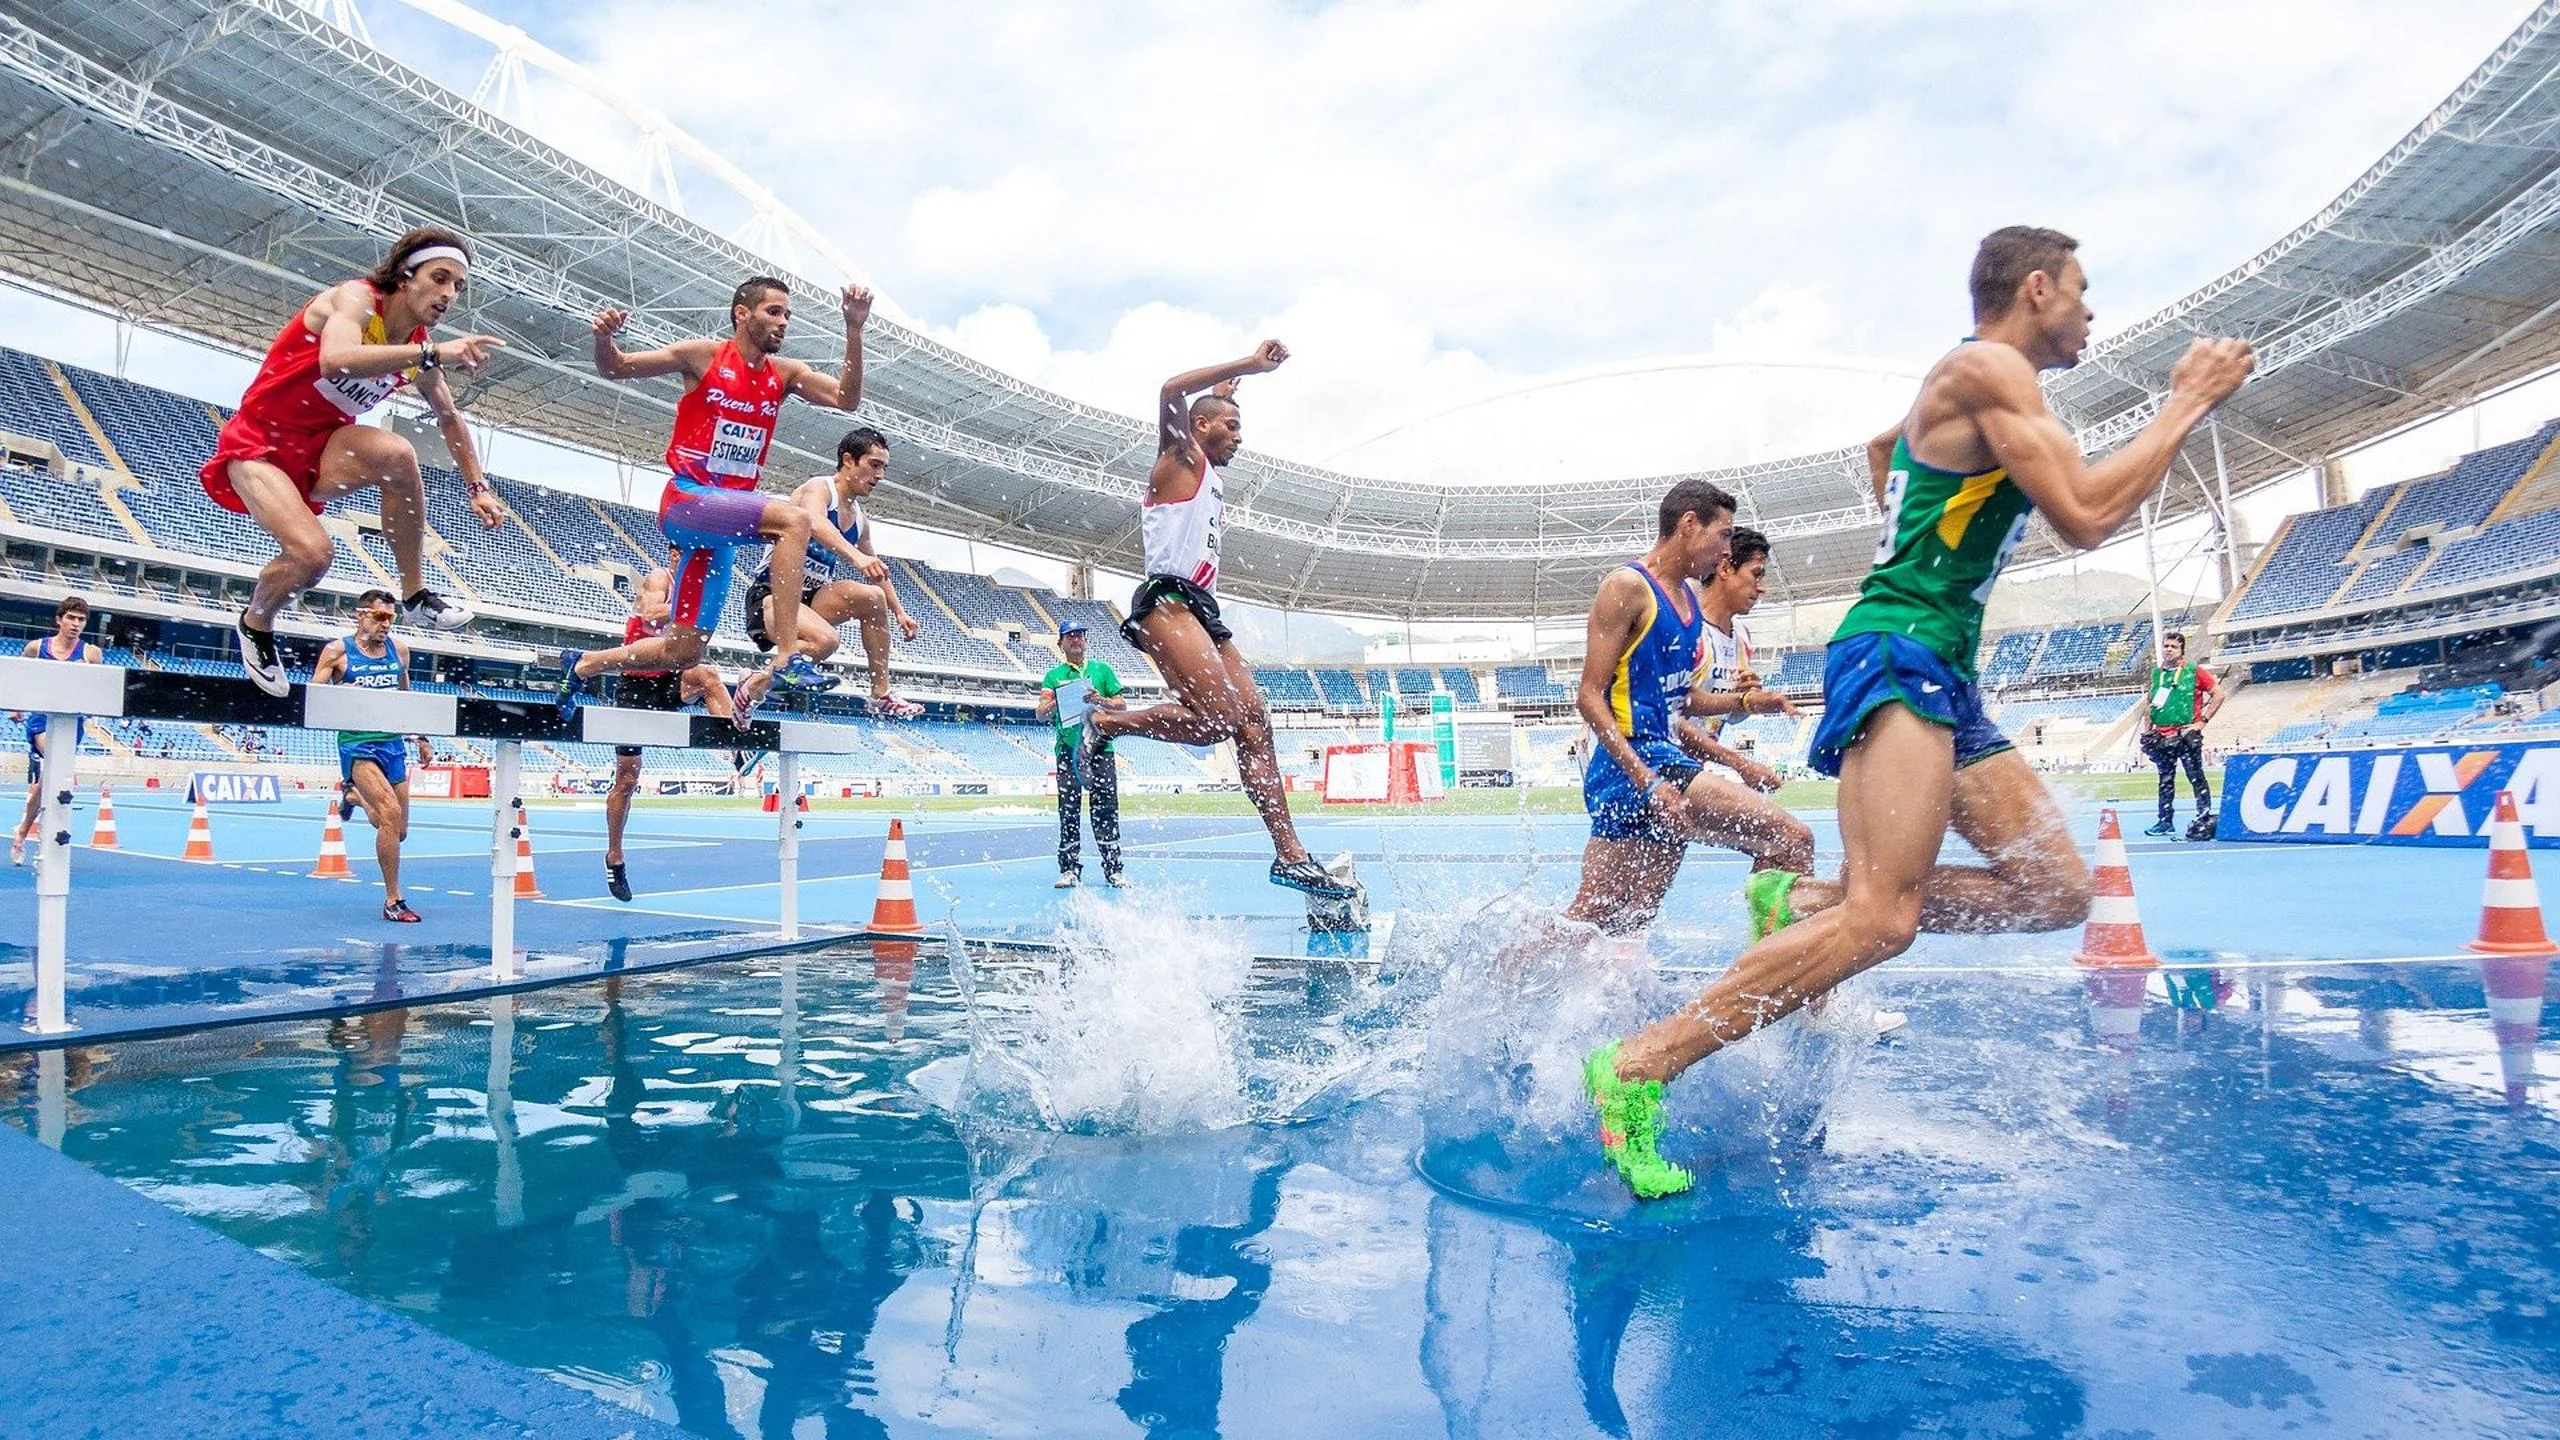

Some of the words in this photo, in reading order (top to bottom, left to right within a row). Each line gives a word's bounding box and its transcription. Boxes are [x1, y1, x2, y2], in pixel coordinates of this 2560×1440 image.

[706, 388, 755, 413] Puerto
[202, 775, 277, 801] CAIXA
[2240, 748, 2560, 836] CAIXA
